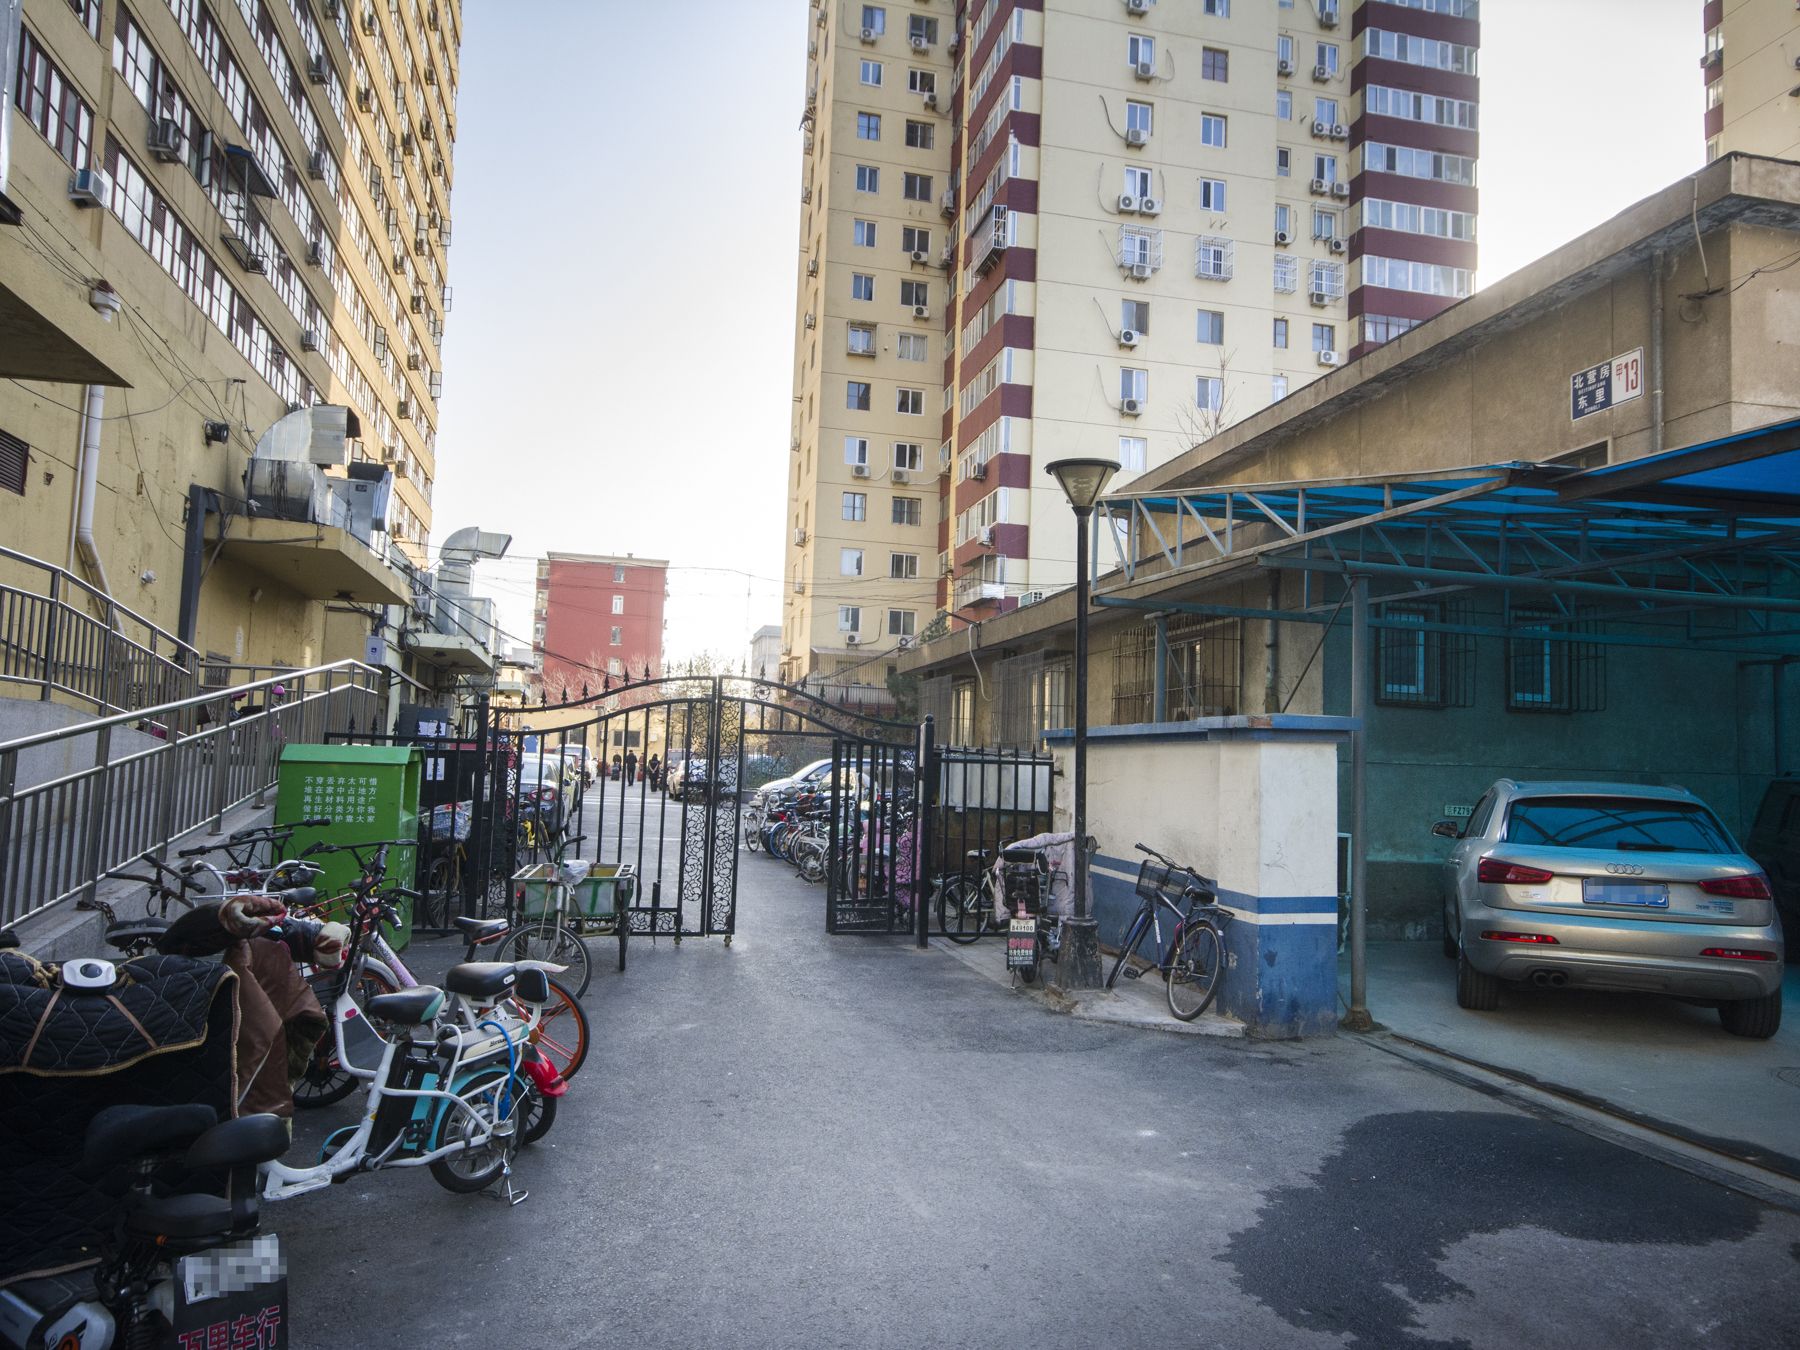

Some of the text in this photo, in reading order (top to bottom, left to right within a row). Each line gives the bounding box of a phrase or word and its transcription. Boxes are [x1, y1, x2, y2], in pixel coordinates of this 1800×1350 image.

[1574, 365, 1611, 388] 北营房
[1578, 388, 1605, 410] 东里
[304, 776, 378, 786] 不穿丢弃太可惜
[304, 786, 377, 795] 堆在家中占地方
[303, 795, 376, 804] 再生材料用途广
[303, 804, 376, 813] 做好分类为你我
